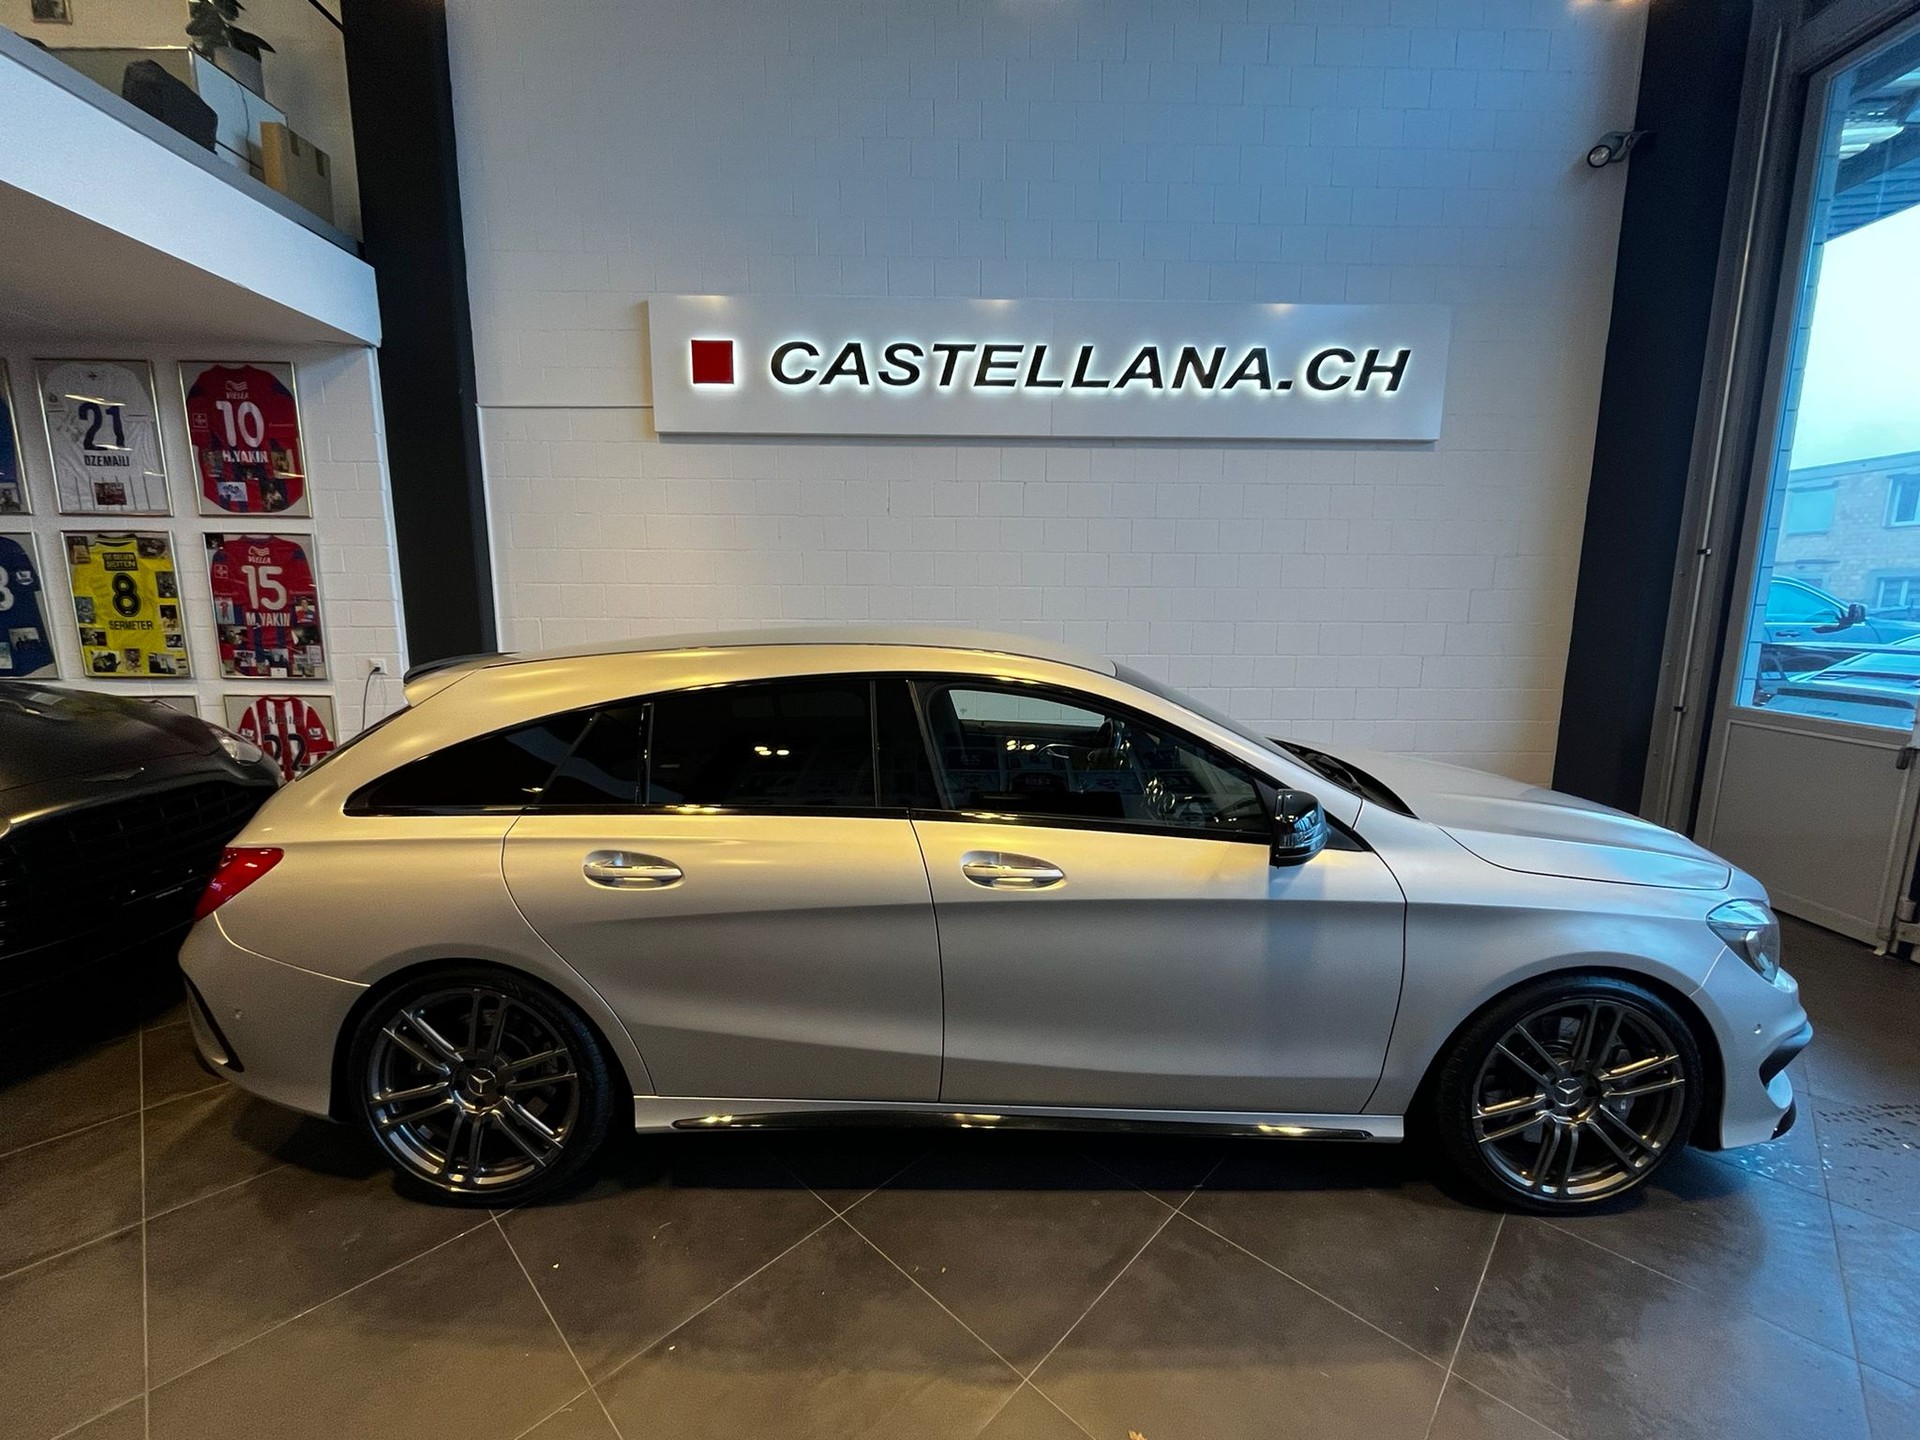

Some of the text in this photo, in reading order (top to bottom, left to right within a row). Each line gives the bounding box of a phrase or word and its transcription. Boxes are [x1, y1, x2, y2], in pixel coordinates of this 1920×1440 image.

[770, 340, 1411, 392] CASTELLANA.CH
[79, 402, 125, 450] 21
[216, 400, 264, 448] 10
[112, 572, 141, 617] 8
[241, 565, 287, 610] 15
